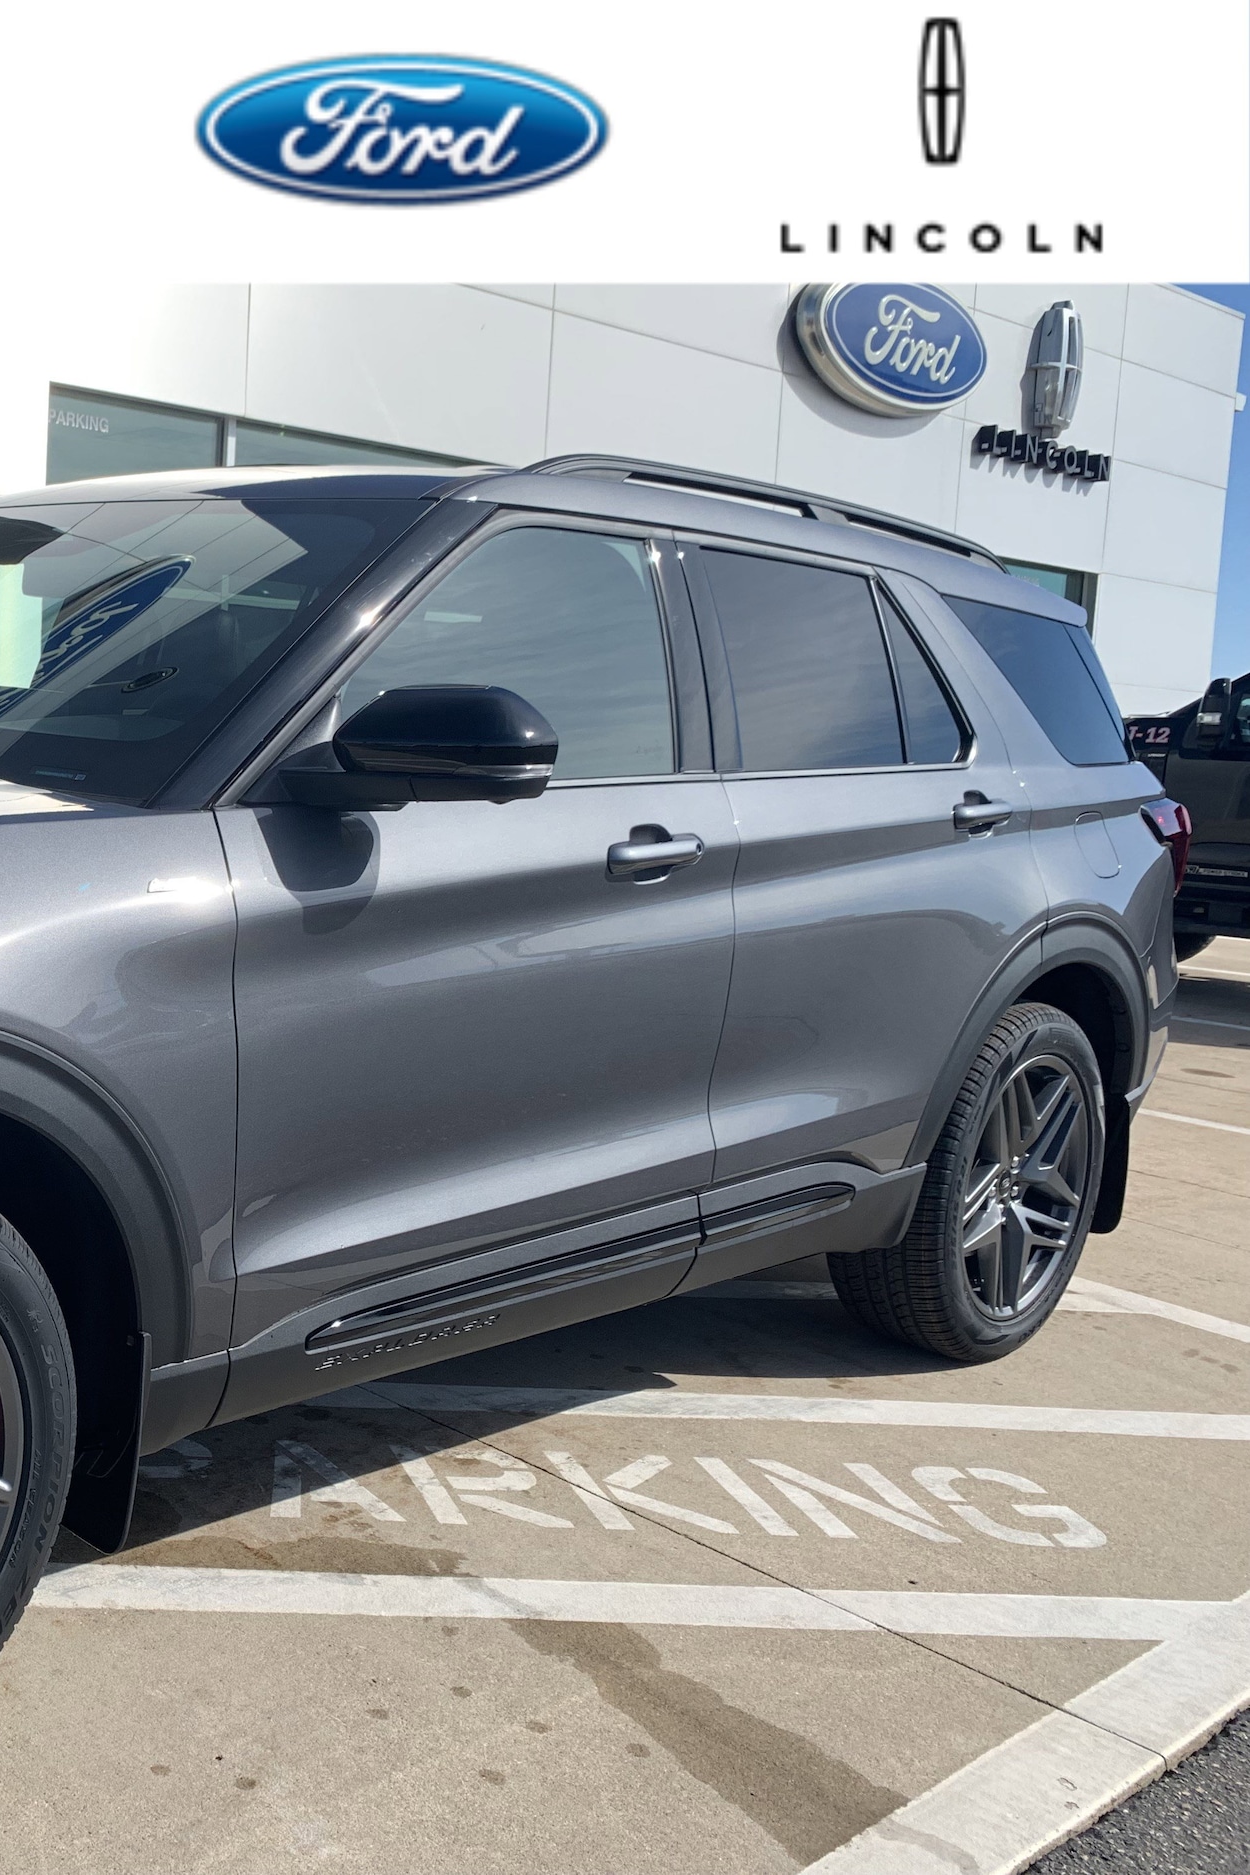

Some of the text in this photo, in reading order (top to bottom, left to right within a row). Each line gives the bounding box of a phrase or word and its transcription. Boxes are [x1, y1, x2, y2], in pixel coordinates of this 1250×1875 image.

[863, 294, 961, 385] Ford
[979, 425, 1112, 482] LINCOLN
[34, 1344, 65, 1554] SCORPION
